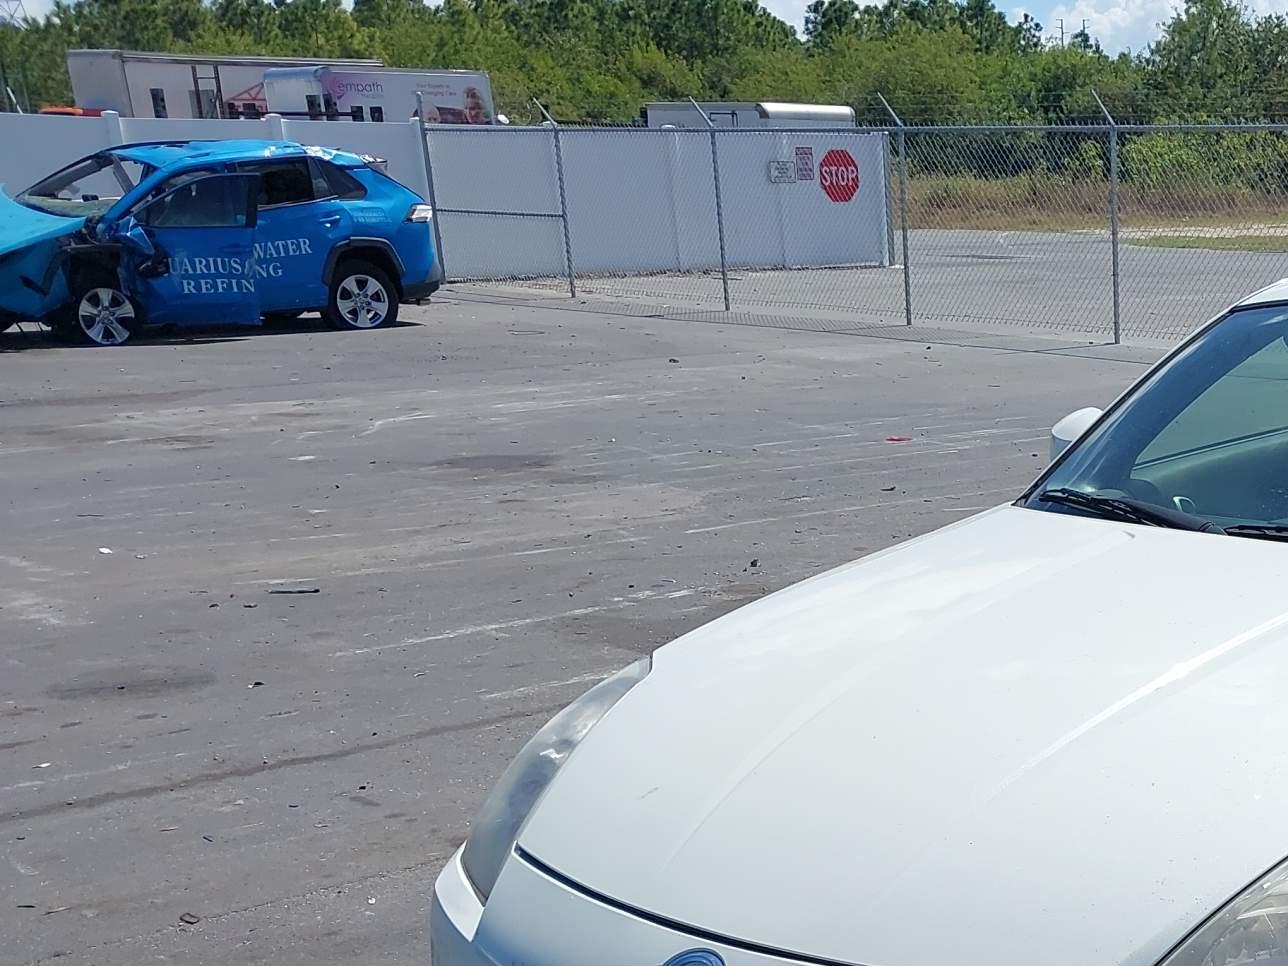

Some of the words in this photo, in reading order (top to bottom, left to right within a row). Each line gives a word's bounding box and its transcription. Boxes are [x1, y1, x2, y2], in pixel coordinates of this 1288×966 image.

[337, 81, 383, 95] empath
[821, 166, 857, 186] STOP
[252, 238, 313, 260] WATER
